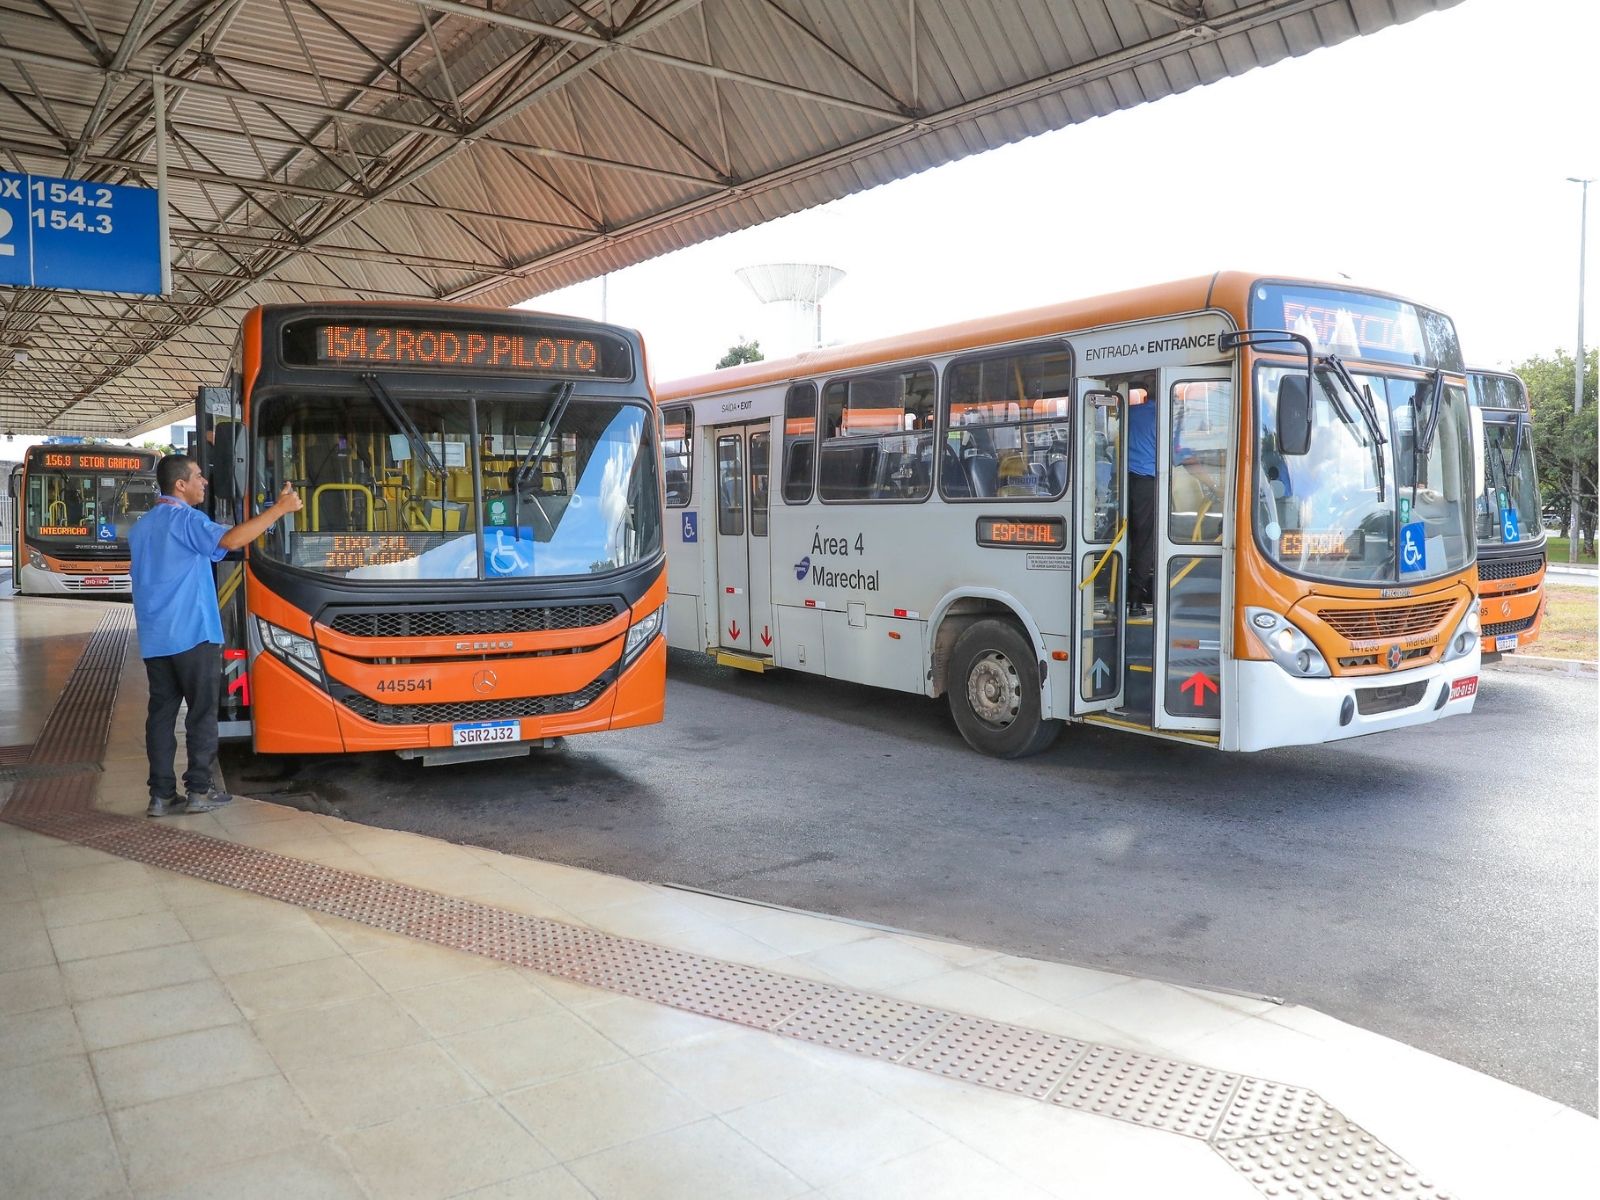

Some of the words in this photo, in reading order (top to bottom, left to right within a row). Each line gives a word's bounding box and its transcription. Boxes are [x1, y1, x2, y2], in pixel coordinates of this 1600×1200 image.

[0, 178, 22, 199] X
[31, 181, 113, 208] 154.2
[32, 208, 113, 234] 154.3
[323, 325, 391, 360] 154.2
[1086, 343, 1138, 361] ENTRADA
[1147, 334, 1216, 353] ENTRANCE
[46, 454, 71, 467] 156.8
[80, 456, 105, 468] SETOR
[108, 457, 140, 469] GRAFICO
[811, 525, 848, 556] Área
[854, 532, 864, 556] 4
[992, 523, 1056, 543] ESPECIAL
[812, 565, 879, 591] Marechal
[376, 678, 432, 692] 445541
[460, 727, 514, 743] SGR2J32
